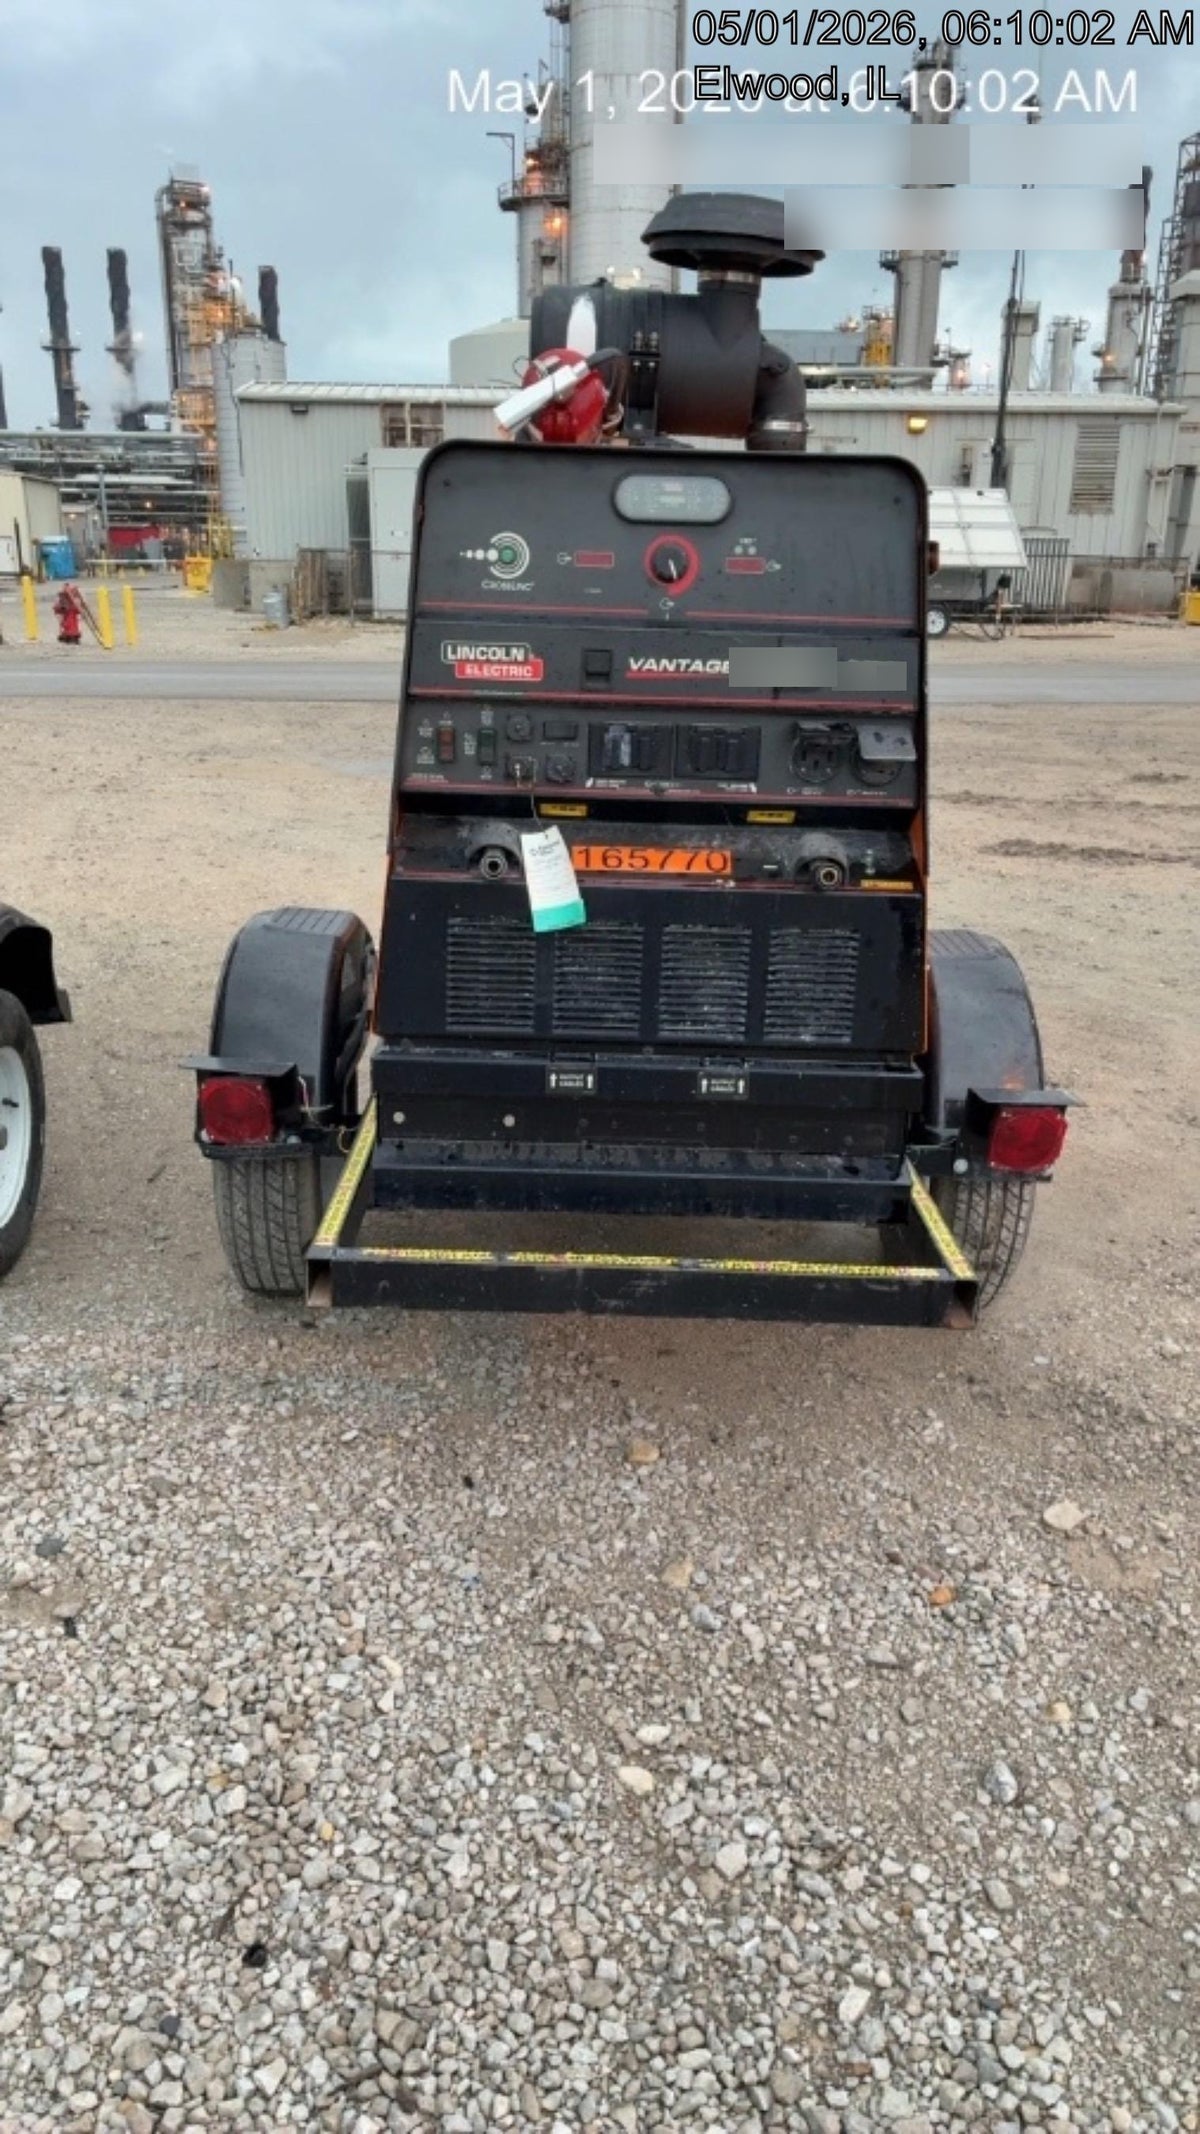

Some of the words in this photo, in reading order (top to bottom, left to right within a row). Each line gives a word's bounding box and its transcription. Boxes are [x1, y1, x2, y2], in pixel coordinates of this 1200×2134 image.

[447, 645, 525, 662] LINCOLN
[464, 662, 534, 678] ELECTRIC
[577, 847, 728, 873] 165770
